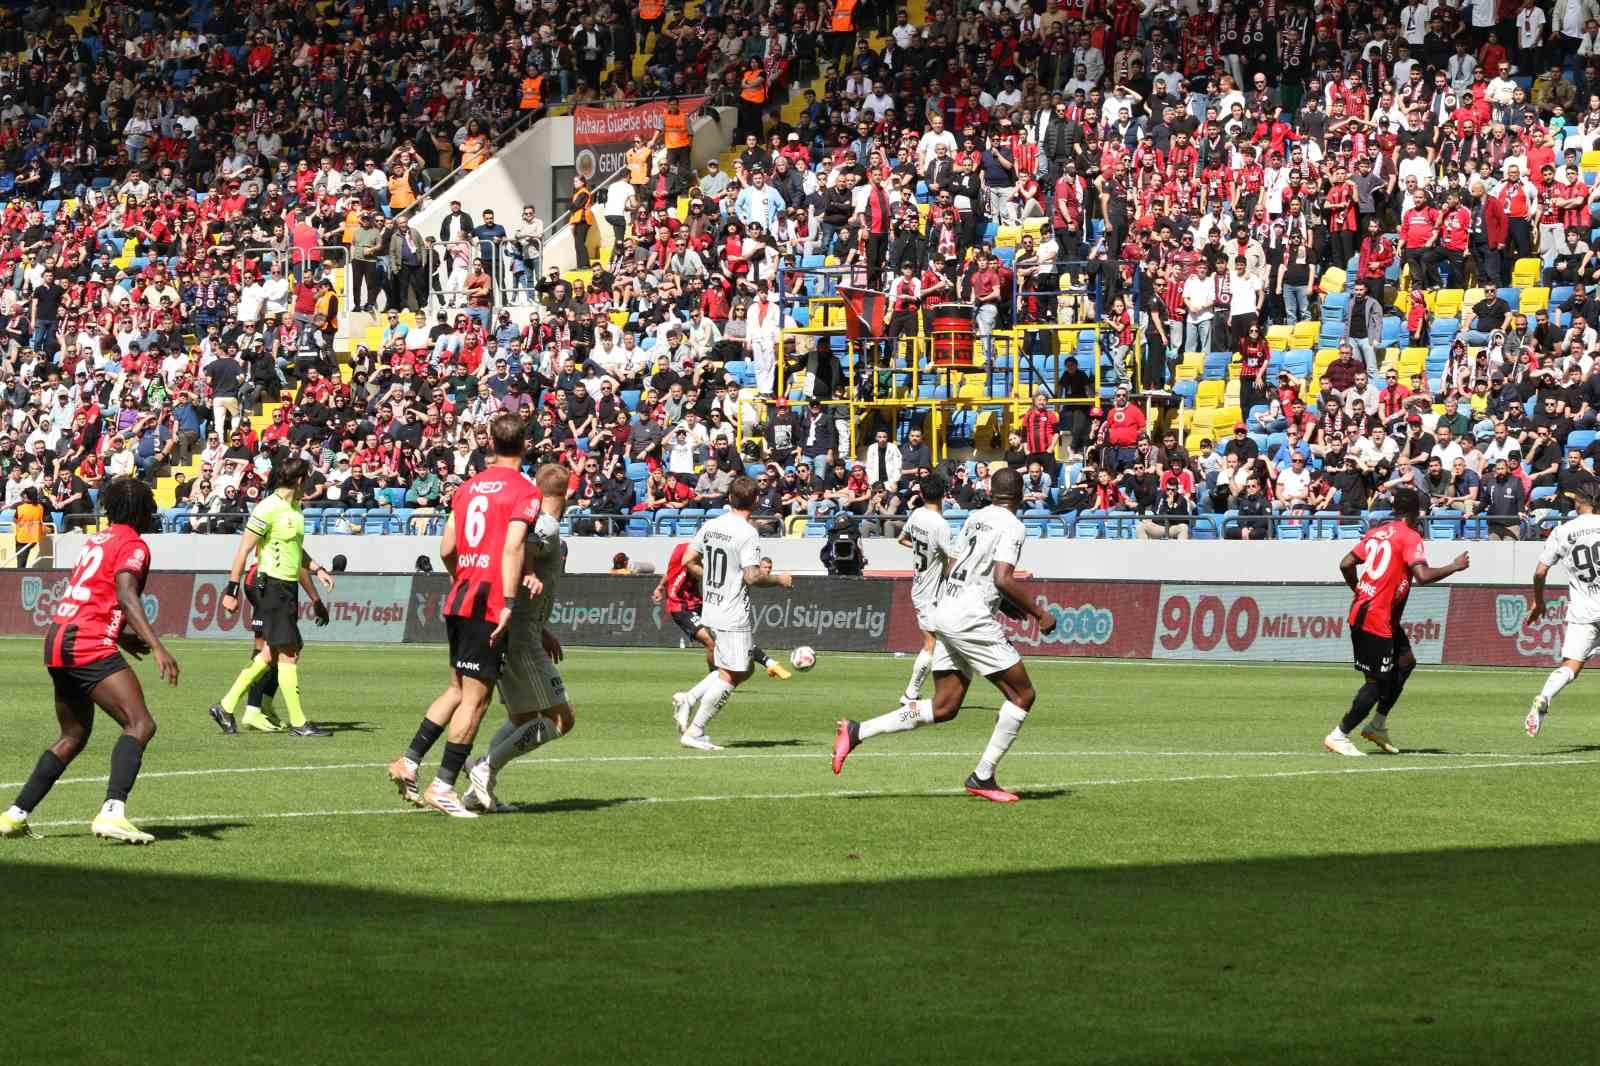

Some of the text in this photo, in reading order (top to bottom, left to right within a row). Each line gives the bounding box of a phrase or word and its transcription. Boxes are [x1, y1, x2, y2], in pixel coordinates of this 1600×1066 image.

[464, 494, 489, 548] 6
[705, 544, 728, 589] 10
[548, 601, 636, 632] SüperLig
[1159, 595, 1260, 653] 900
